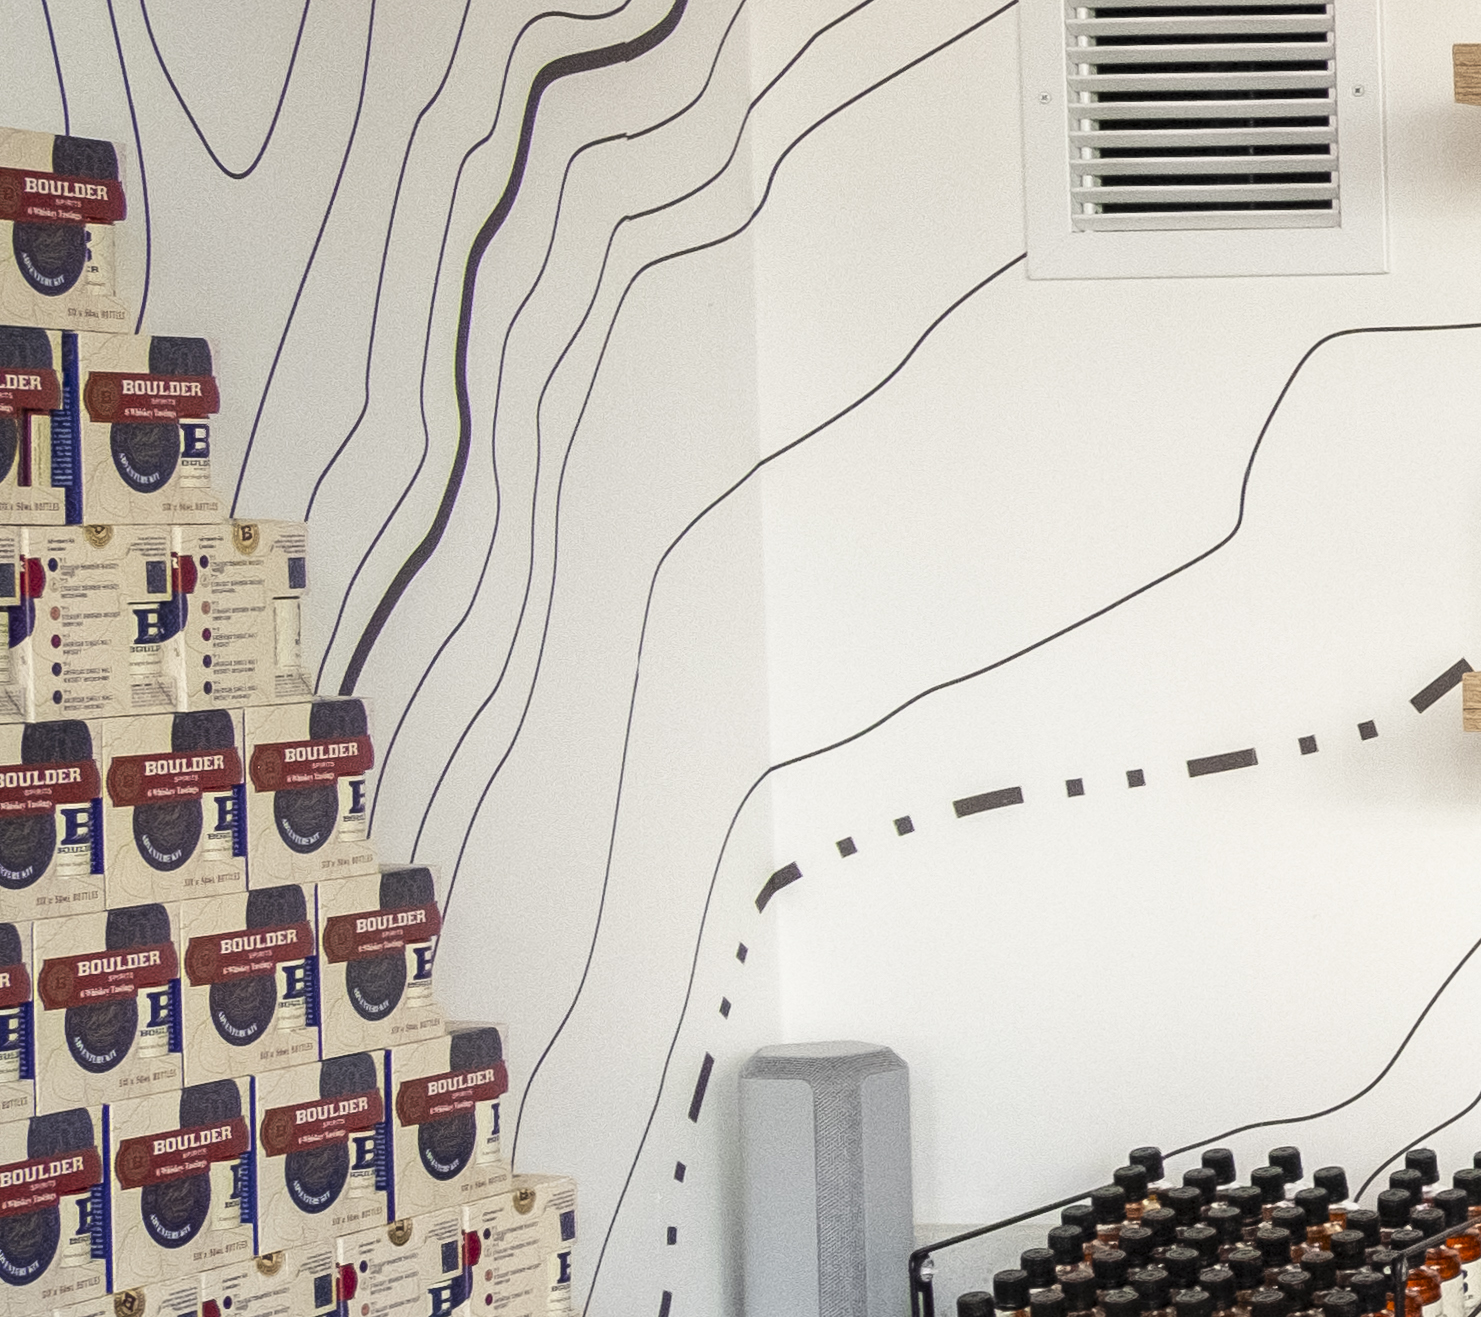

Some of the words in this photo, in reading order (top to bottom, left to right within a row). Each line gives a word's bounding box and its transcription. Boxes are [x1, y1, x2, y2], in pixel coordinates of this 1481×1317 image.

[25, 177, 108, 202] BOULDER
[122, 379, 203, 397] BOULDER
[284, 742, 360, 763] BOULDER
[144, 755, 225, 776] BOULDER
[220, 929, 298, 954] BOULDER
[77, 950, 161, 977] BOULDER
[295, 1096, 368, 1125] BOULDER
[153, 1126, 233, 1157] BOULDER
